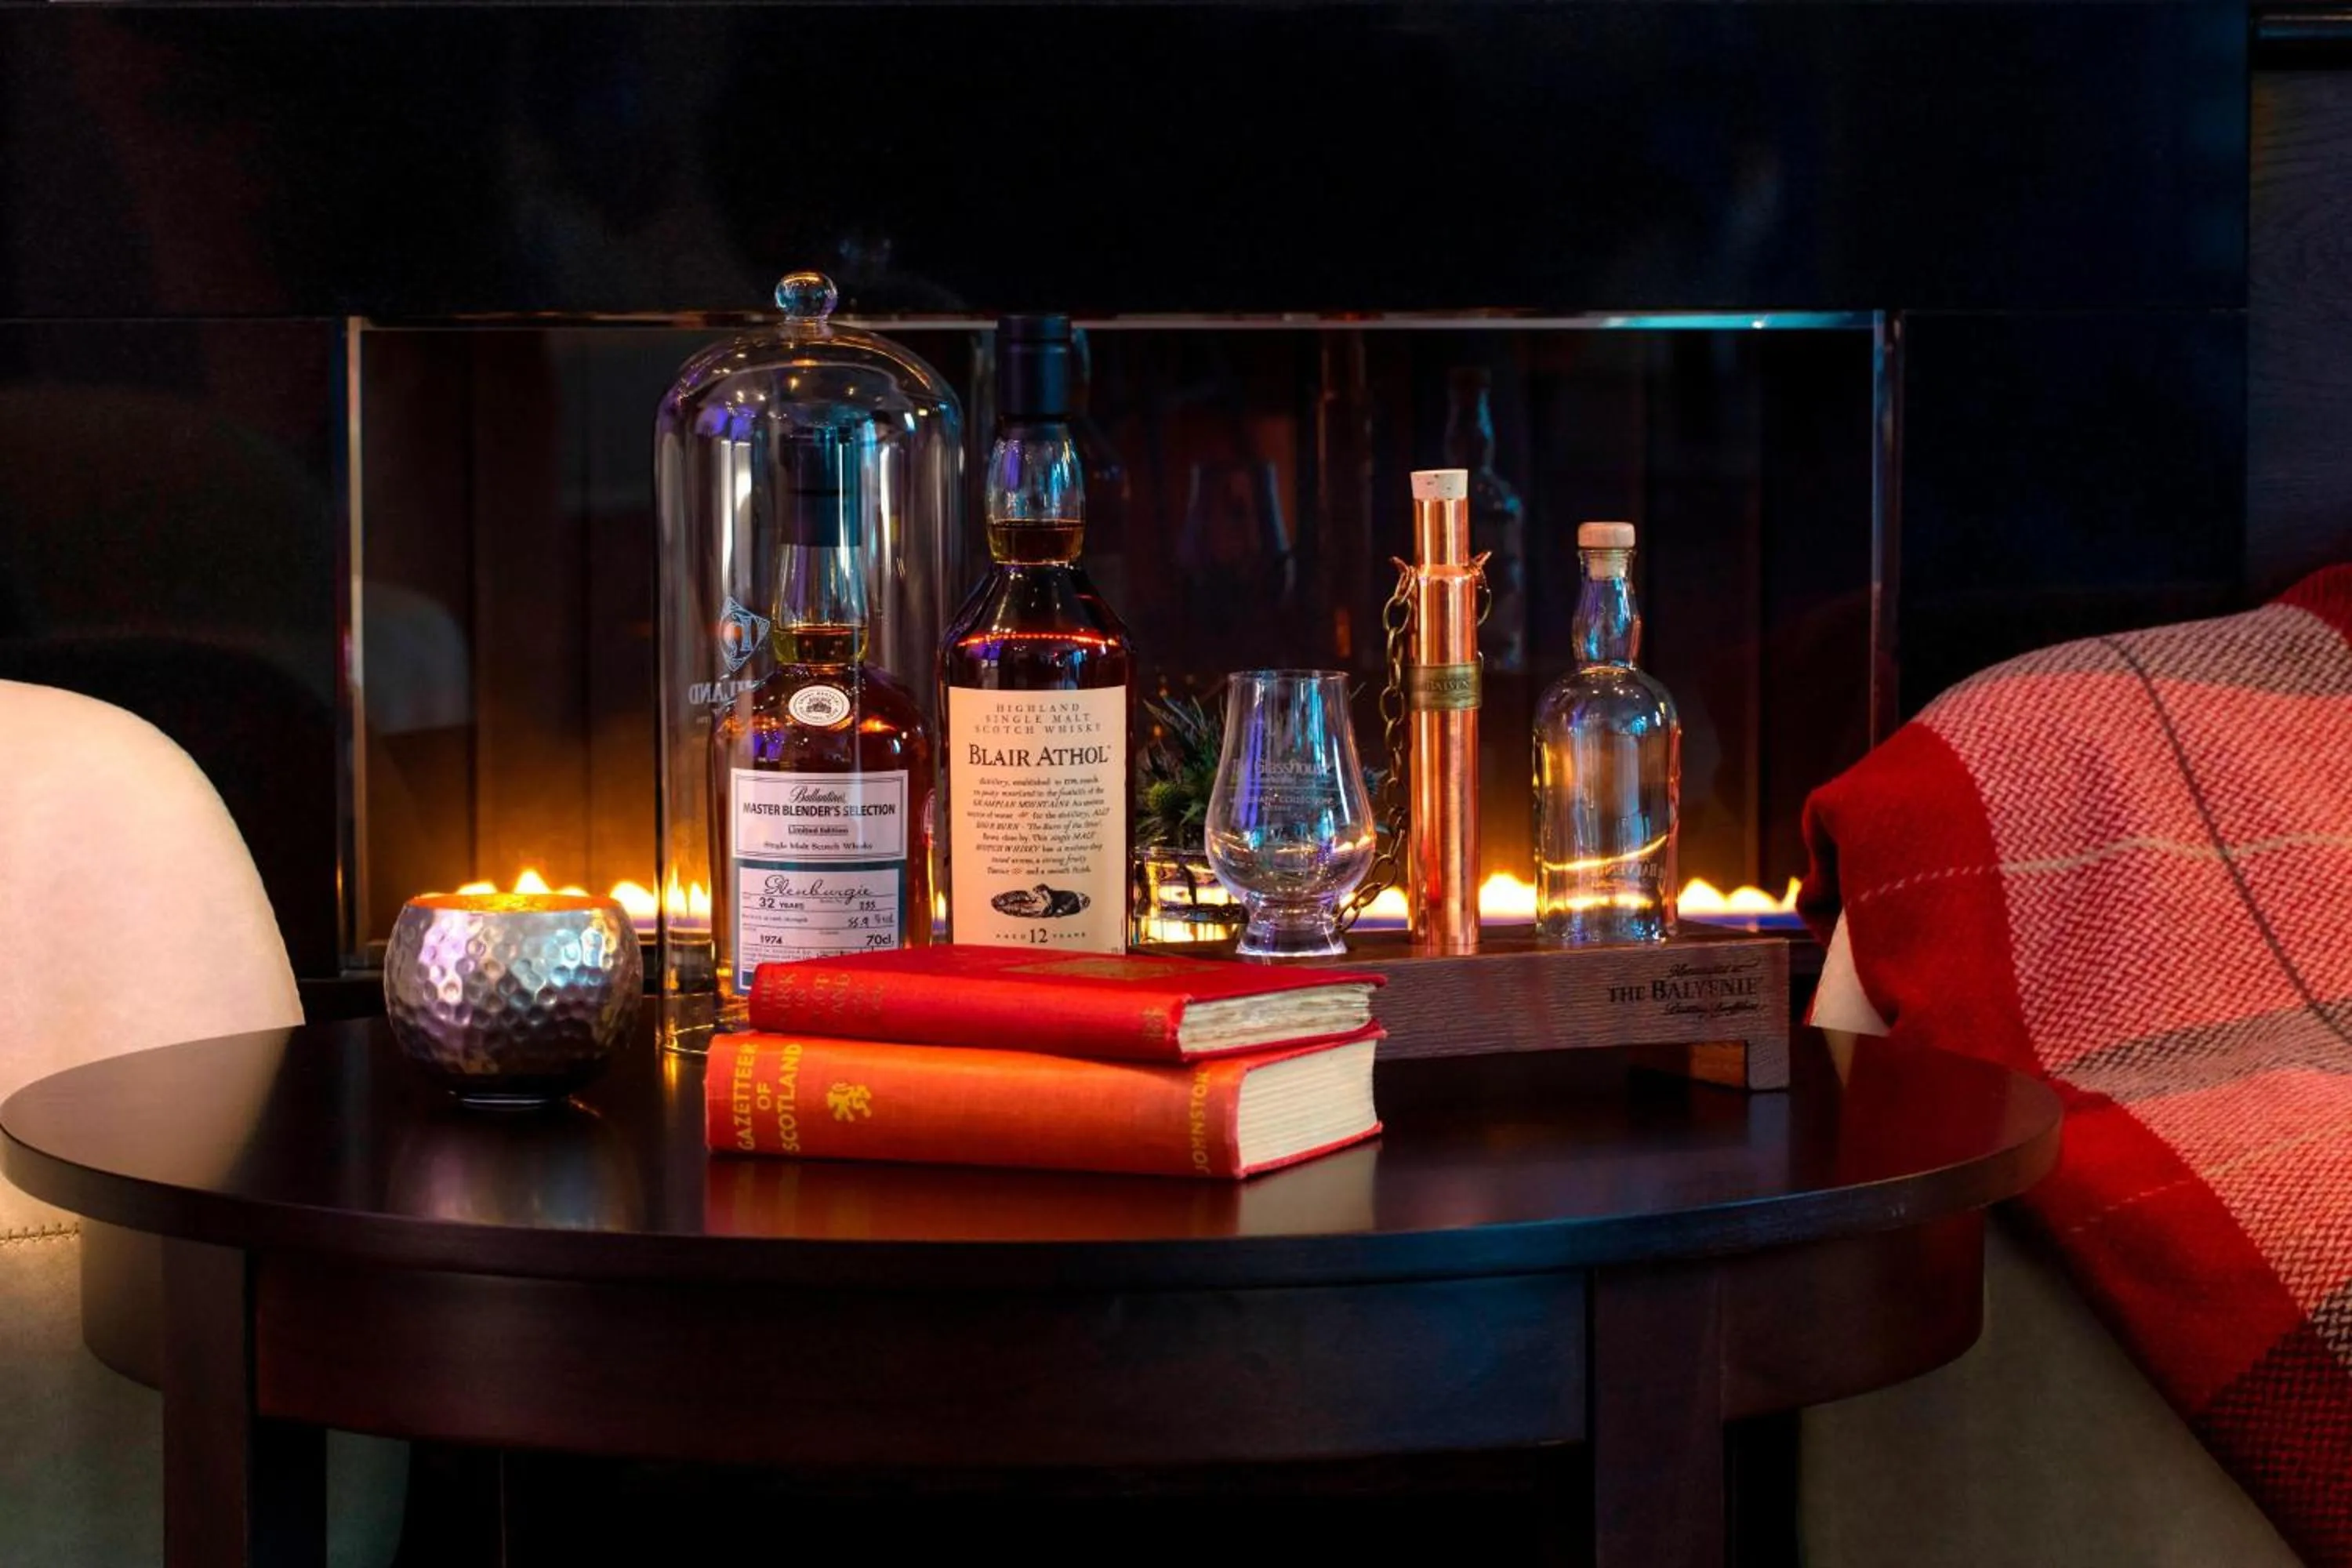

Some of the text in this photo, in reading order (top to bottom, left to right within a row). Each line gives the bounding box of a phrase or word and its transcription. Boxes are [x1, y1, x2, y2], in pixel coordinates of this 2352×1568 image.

[996, 702, 1080, 714] HIGHLAND
[985, 713, 1091, 724] SINGLE MALT
[974, 724, 1035, 735] SCOTCH
[968, 742, 1109, 768] BLAIR ATHOL
[742, 801, 897, 817] MASTER BLENDER'S SELECTION
[759, 896, 805, 911] 32 YEARS
[760, 934, 782, 945] 1974
[1029, 927, 1048, 944] 12
[1607, 985, 1646, 1004] THE
[733, 1043, 760, 1152] GAZETTEER
[757, 1081, 772, 1111] OF
[776, 1044, 804, 1153] SCOTLAND
[1189, 1071, 1212, 1175] JOHNSTON
